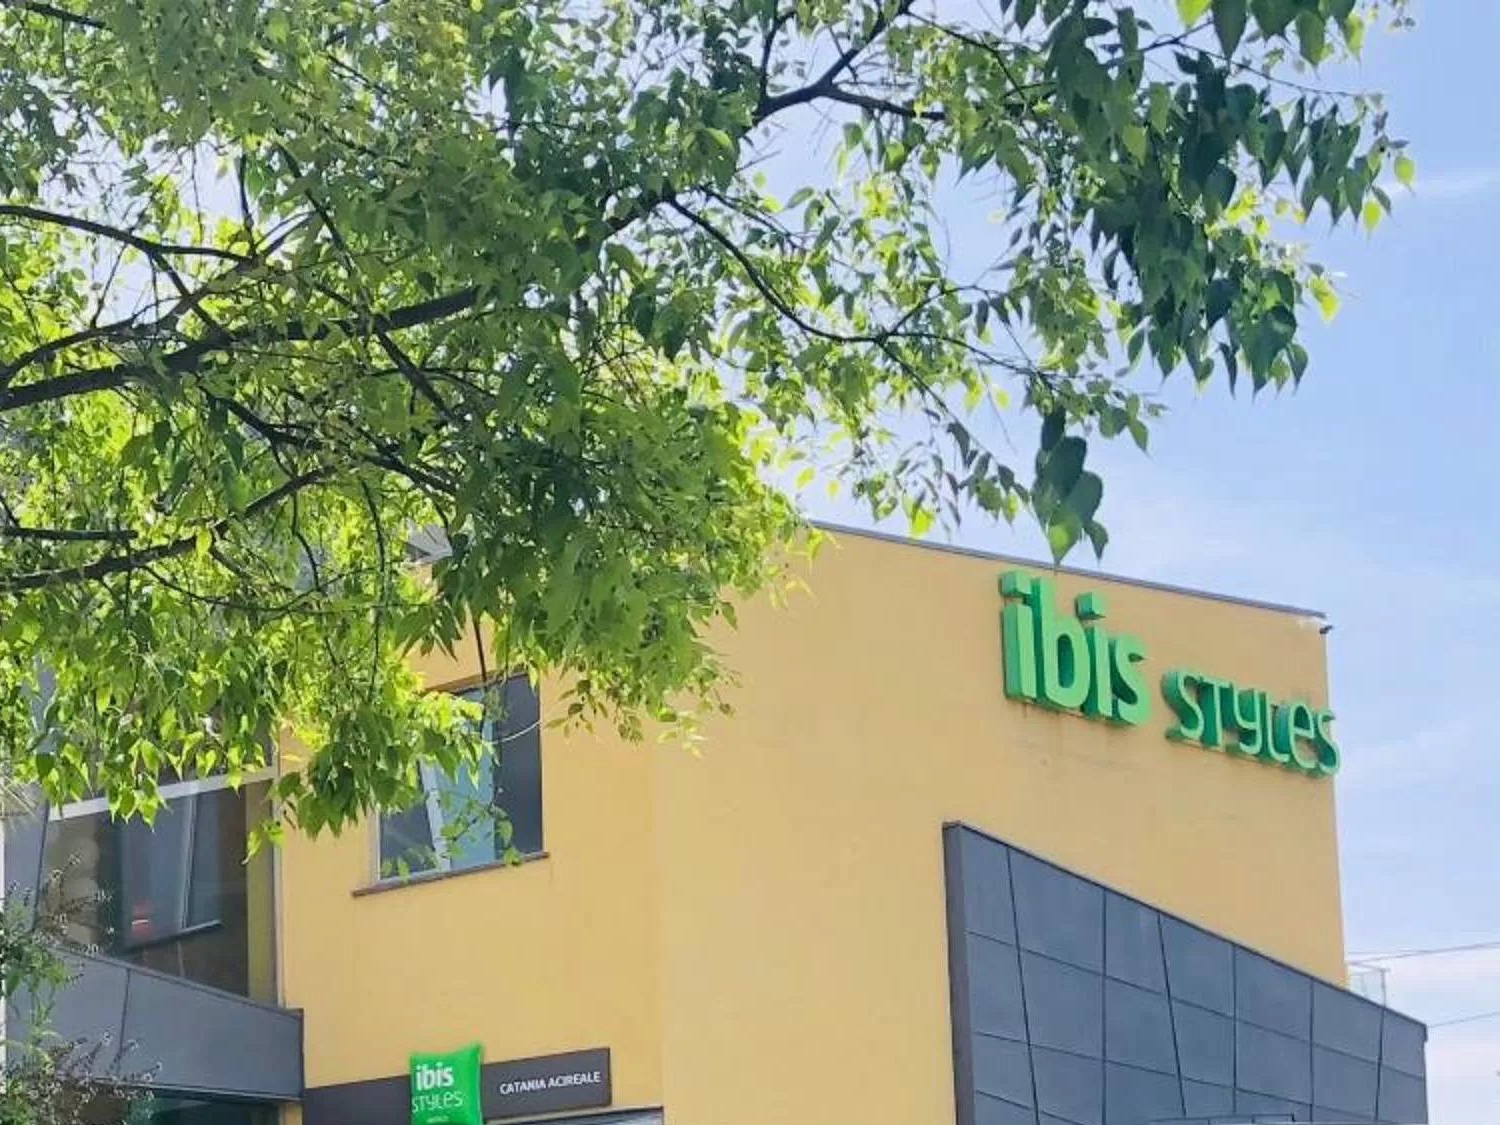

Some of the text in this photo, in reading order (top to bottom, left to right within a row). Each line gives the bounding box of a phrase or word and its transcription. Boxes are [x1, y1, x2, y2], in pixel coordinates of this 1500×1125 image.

[1000, 570, 1151, 727] ibis
[416, 1062, 454, 1090] ibis
[499, 1071, 602, 1096] CATANIA ACIREALE
